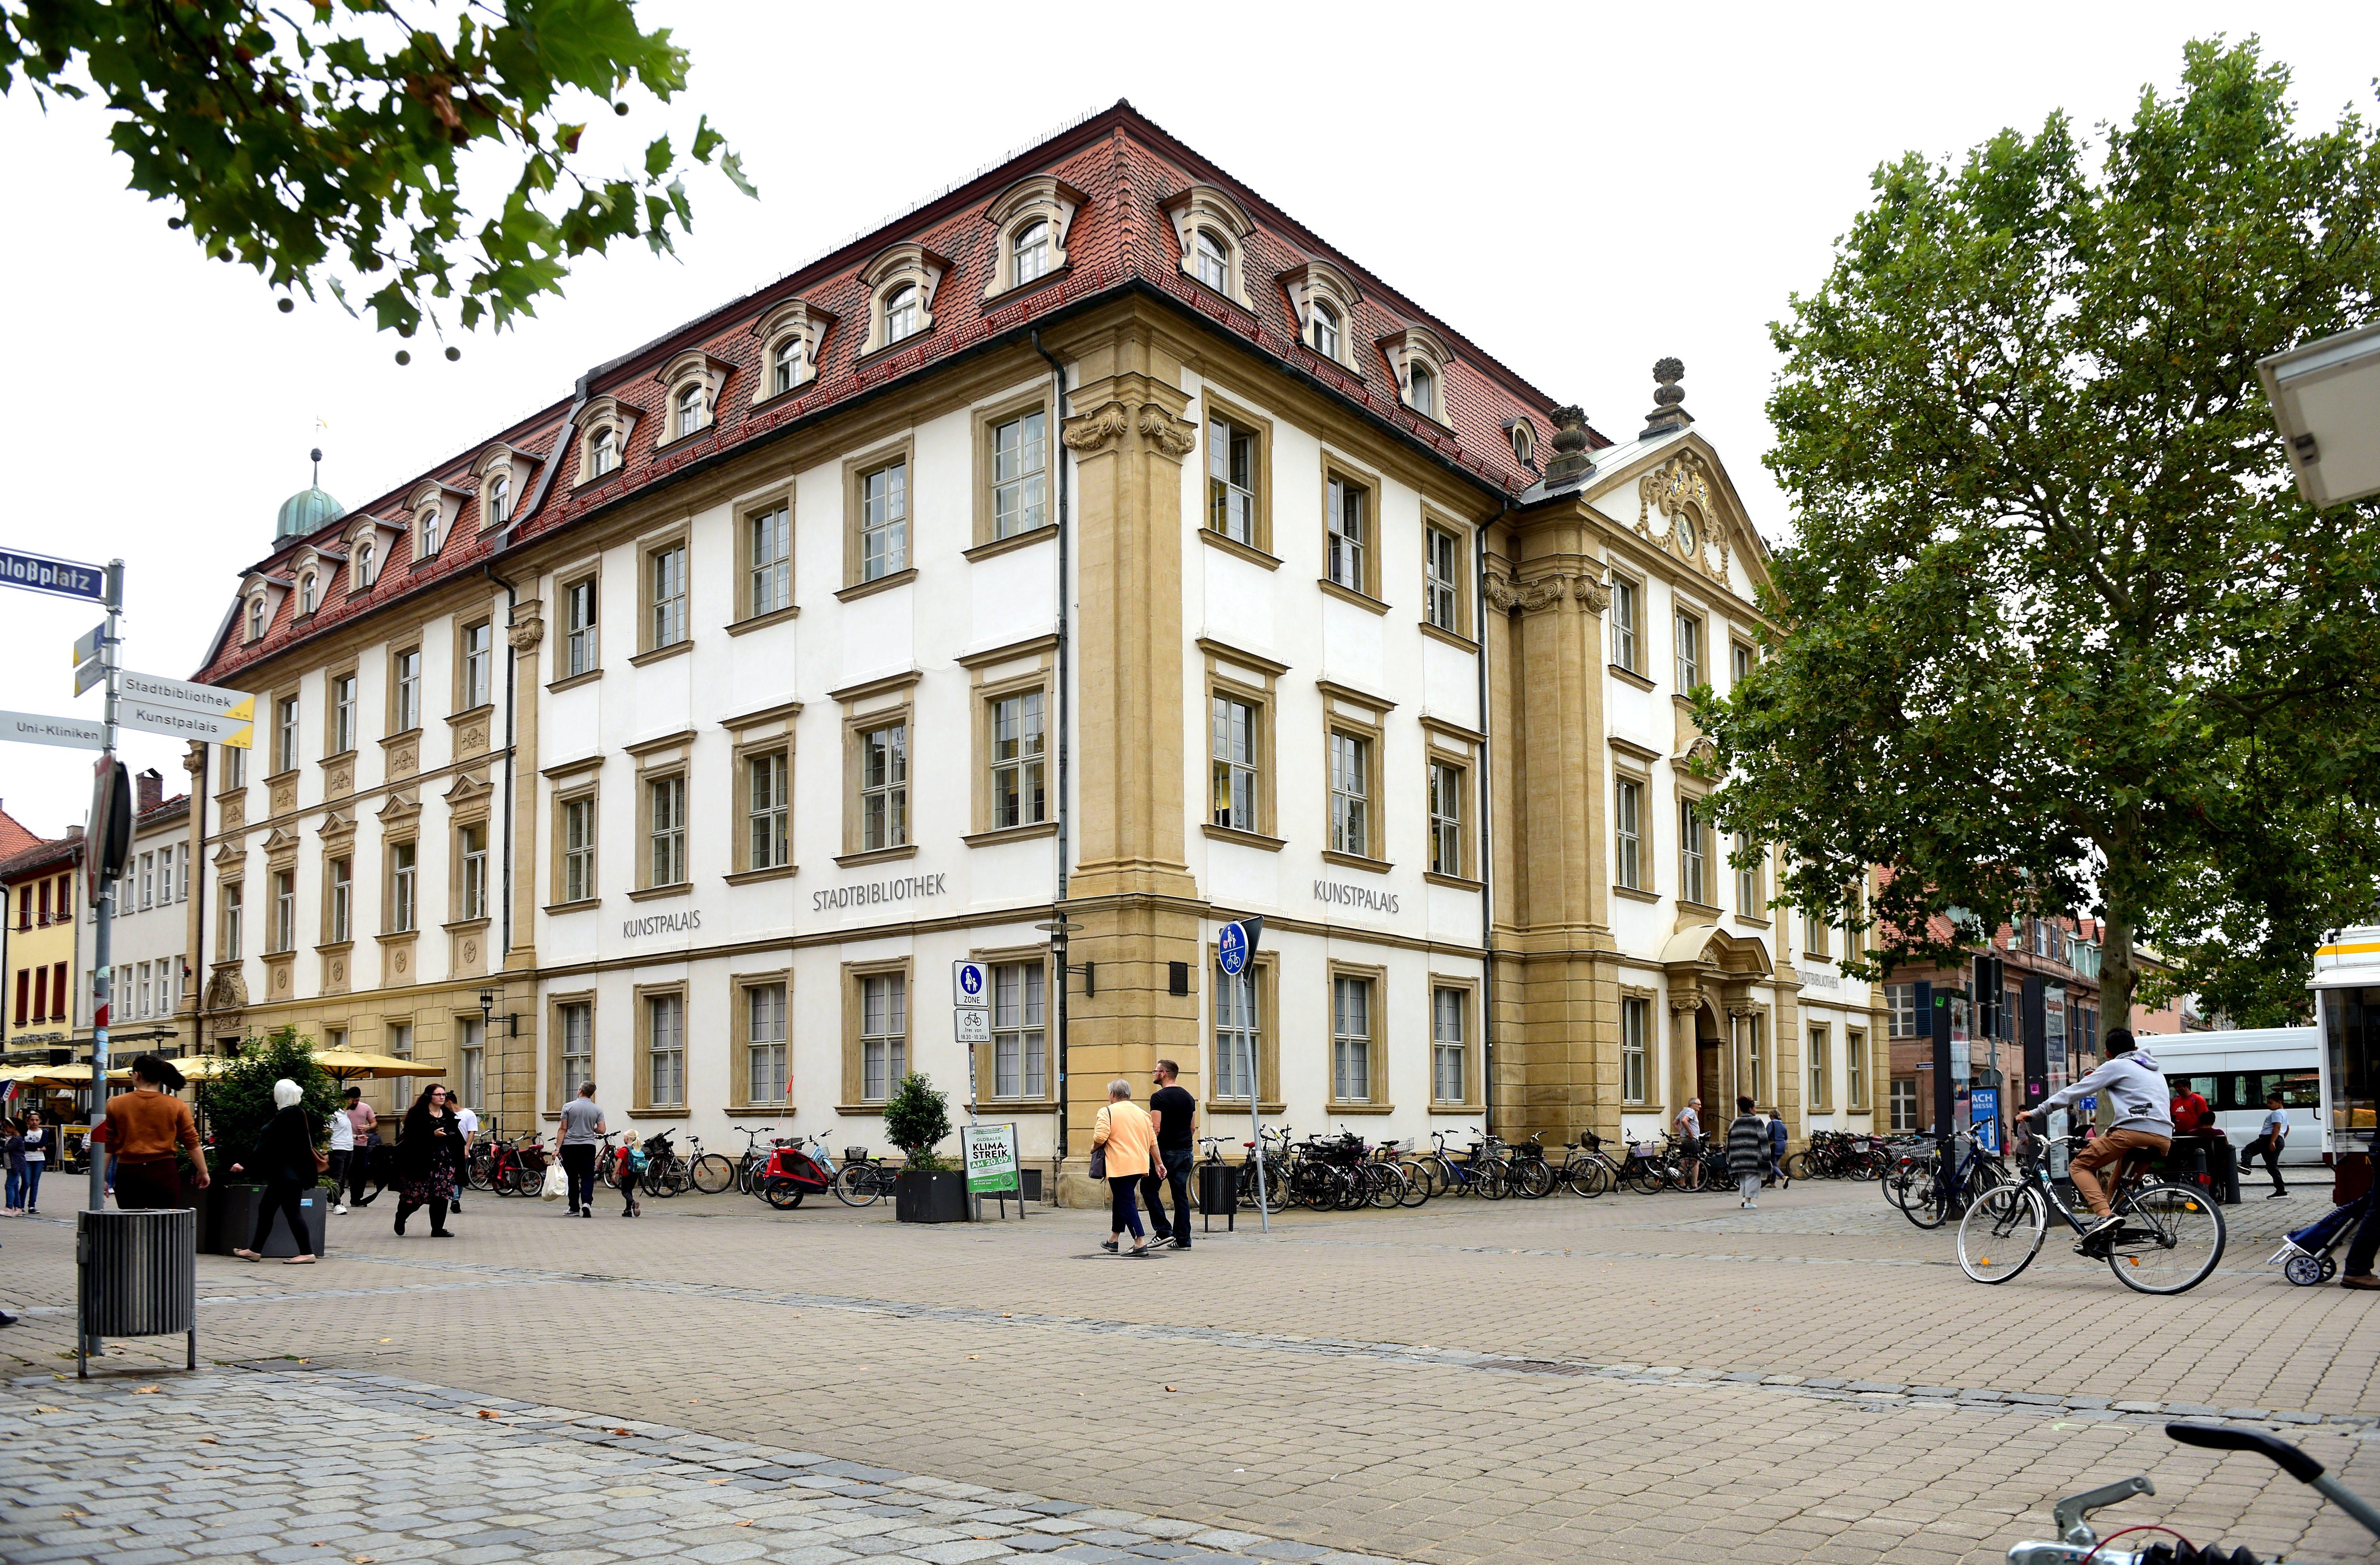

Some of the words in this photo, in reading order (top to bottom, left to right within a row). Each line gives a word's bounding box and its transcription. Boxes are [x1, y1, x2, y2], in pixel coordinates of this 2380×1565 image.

[126, 679, 231, 708] Stadtbibliothek
[136, 709, 218, 733] Kunstpalais
[17, 722, 99, 740] Uni-Kliniken
[813, 873, 946, 911] STADTBIBLIOTHEK
[1314, 879, 1399, 913] KUNSTPALAIS
[623, 910, 701, 938] KUNSTPALAIS
[121, 1054, 139, 1067] Caf
[1972, 1094, 1993, 1103] ACH
[973, 1141, 1007, 1151] KLIMA-
[973, 1149, 1008, 1159] STREIK
[986, 1156, 1011, 1165] 20.09.
